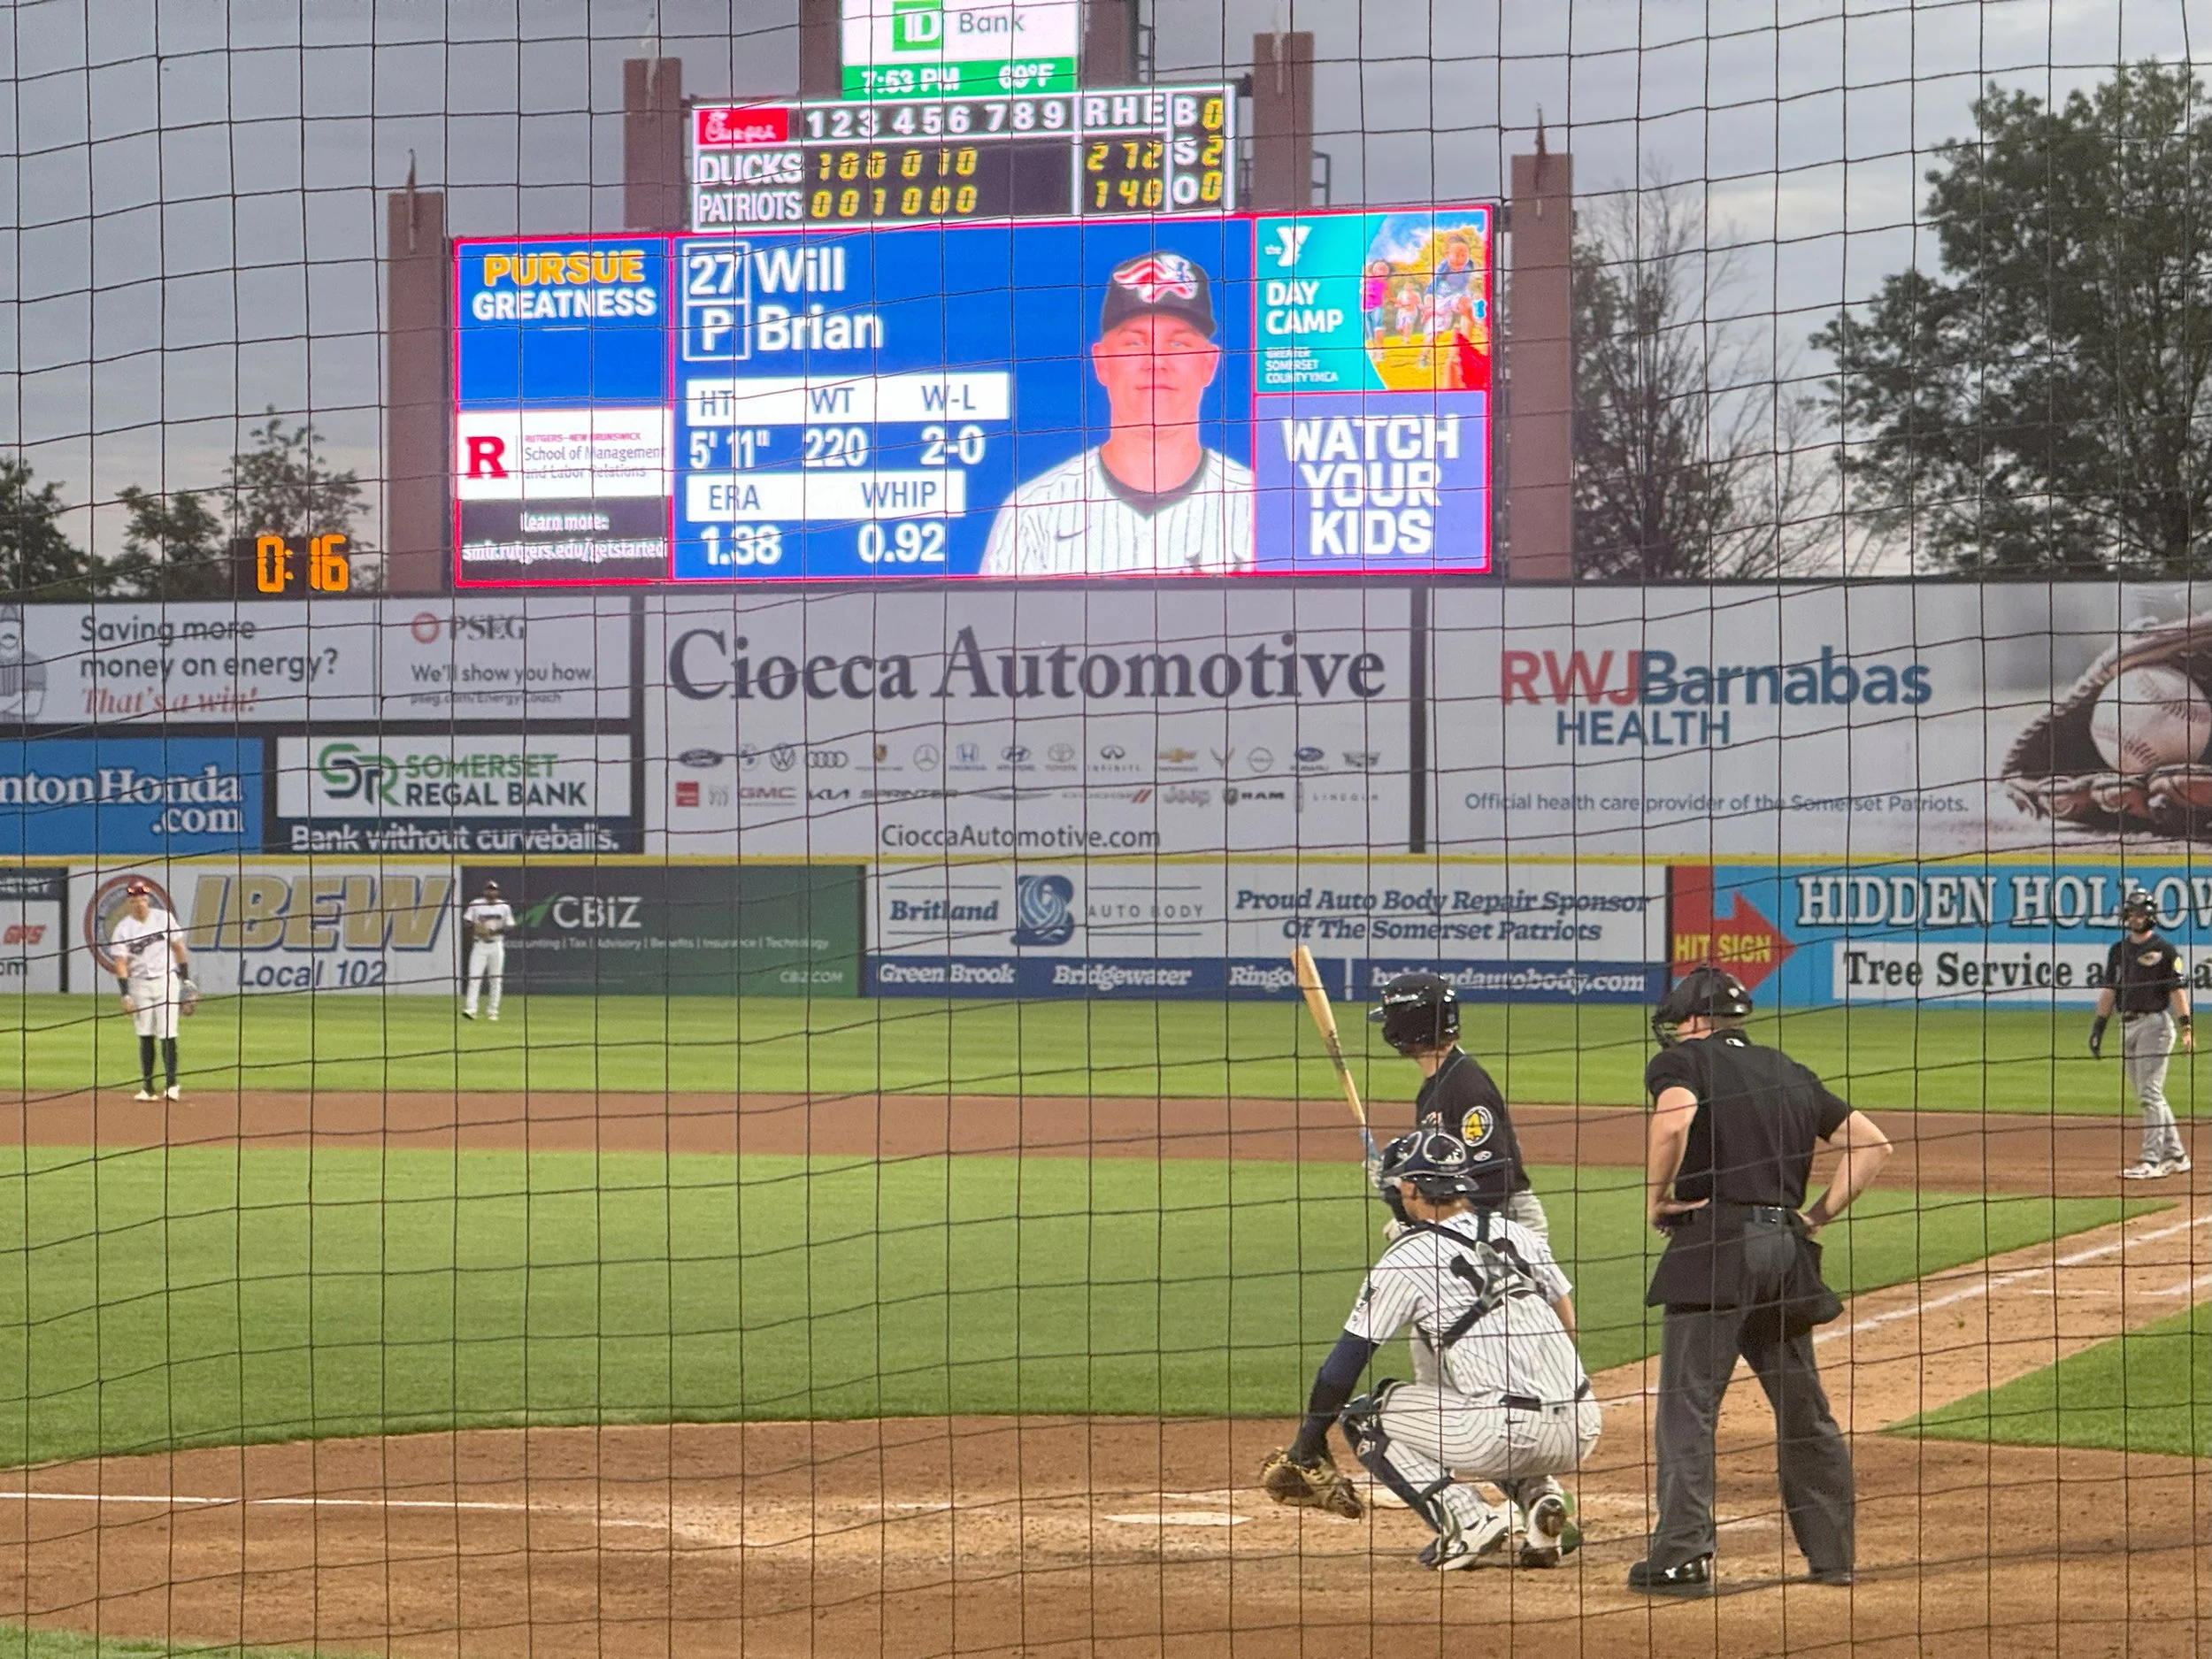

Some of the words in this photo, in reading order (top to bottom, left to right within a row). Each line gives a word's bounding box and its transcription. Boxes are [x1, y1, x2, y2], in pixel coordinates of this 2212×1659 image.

[958, 12, 1026, 34] Bank
[861, 69, 915, 95] 7:53
[919, 66, 961, 92] PM
[1173, 96, 1195, 127] B
[1202, 97, 1224, 130] 0
[1173, 137, 1198, 166] S
[1202, 134, 1224, 167] 2
[699, 151, 803, 185] DUCKS
[1201, 170, 1224, 203] 0
[699, 190, 803, 223] PATRIOTS
[1275, 225, 1313, 267] Y
[483, 250, 646, 287] PURSUE
[688, 251, 742, 296] 27
[754, 246, 846, 293] Will
[472, 287, 657, 321] GREATNESS
[1265, 280, 1319, 306] DAY
[701, 308, 734, 352] P
[757, 303, 883, 352] Brian
[1265, 309, 1343, 334] CAMP
[701, 389, 733, 417] HT
[811, 387, 856, 414] WT
[921, 384, 977, 411] W-L
[525, 445, 565, 461] School
[569, 445, 582, 459] of
[585, 445, 667, 463] Management
[803, 426, 868, 468] 220
[919, 425, 987, 465] 2-0
[1282, 413, 1459, 462] WATCH
[465, 435, 510, 480] R
[709, 484, 761, 511] ERA
[860, 480, 937, 508] WHIP
[1299, 461, 1441, 508] YOUR
[700, 524, 783, 566] 1.38
[856, 521, 946, 565] 0.92
[1310, 508, 1432, 556] KIDS
[257, 534, 349, 593] 0:16
[80, 615, 174, 647] Saving
[183, 620, 257, 641] more
[449, 614, 526, 641] PSEG
[80, 658, 175, 685] money
[182, 658, 216, 676] on
[224, 648, 339, 683] energy?
[411, 663, 457, 682] We'll
[462, 665, 509, 681] show
[516, 667, 548, 687] you
[669, 627, 919, 701] Ciocca
[929, 625, 1386, 701] Automotive
[1500, 645, 1933, 706] RWJBarnabas
[82, 687, 165, 715] That's
[173, 695, 191, 712] a
[1555, 710, 1731, 746] HEALTH
[405, 755, 559, 779] SOMERSET
[405, 782, 501, 806] REGAL
[507, 782, 588, 807] BANK
[1464, 792, 1532, 810] Official
[1537, 793, 1594, 810] health
[1599, 796, 1640, 811] care
[1646, 793, 1724, 814] provider
[1729, 793, 1748, 810] of
[1755, 794, 1782, 810] the
[1791, 795, 1881, 812] Somerset
[1888, 795, 1970, 812] Patriots.
[151, 806, 245, 833] .com
[881, 823, 1160, 848] CioccaAutomotive.com
[290, 825, 361, 851] Bank
[365, 823, 469, 851] without
[187, 873, 454, 953] IBEW
[888, 899, 1000, 922] Britland
[1087, 903, 1141, 919] AUTO
[1149, 902, 1204, 918] BODY
[1235, 887, 1313, 910] Proud
[1316, 888, 1376, 910] Auto
[1382, 887, 1448, 917] Body
[1451, 888, 1538, 917] Repair
[1540, 890, 1651, 918] Sponsor
[1796, 875, 2000, 927] HIDDEN
[1282, 917, 1314, 940] Of
[1318, 918, 1366, 940] The
[1370, 918, 1494, 941] Somerset
[1496, 919, 1602, 941] Patriots
[1673, 933, 1710, 962] HIT
[1717, 933, 1771, 964] SIGN
[237, 958, 323, 987] Local
[337, 959, 388, 987] 102
[879, 962, 946, 985] Green
[949, 962, 1017, 985] Brook
[1052, 963, 1193, 992] Bridgewater
[1229, 964, 1296, 993] Ringo
[1844, 951, 1924, 988] Tree
[1935, 951, 2073, 988] Service
